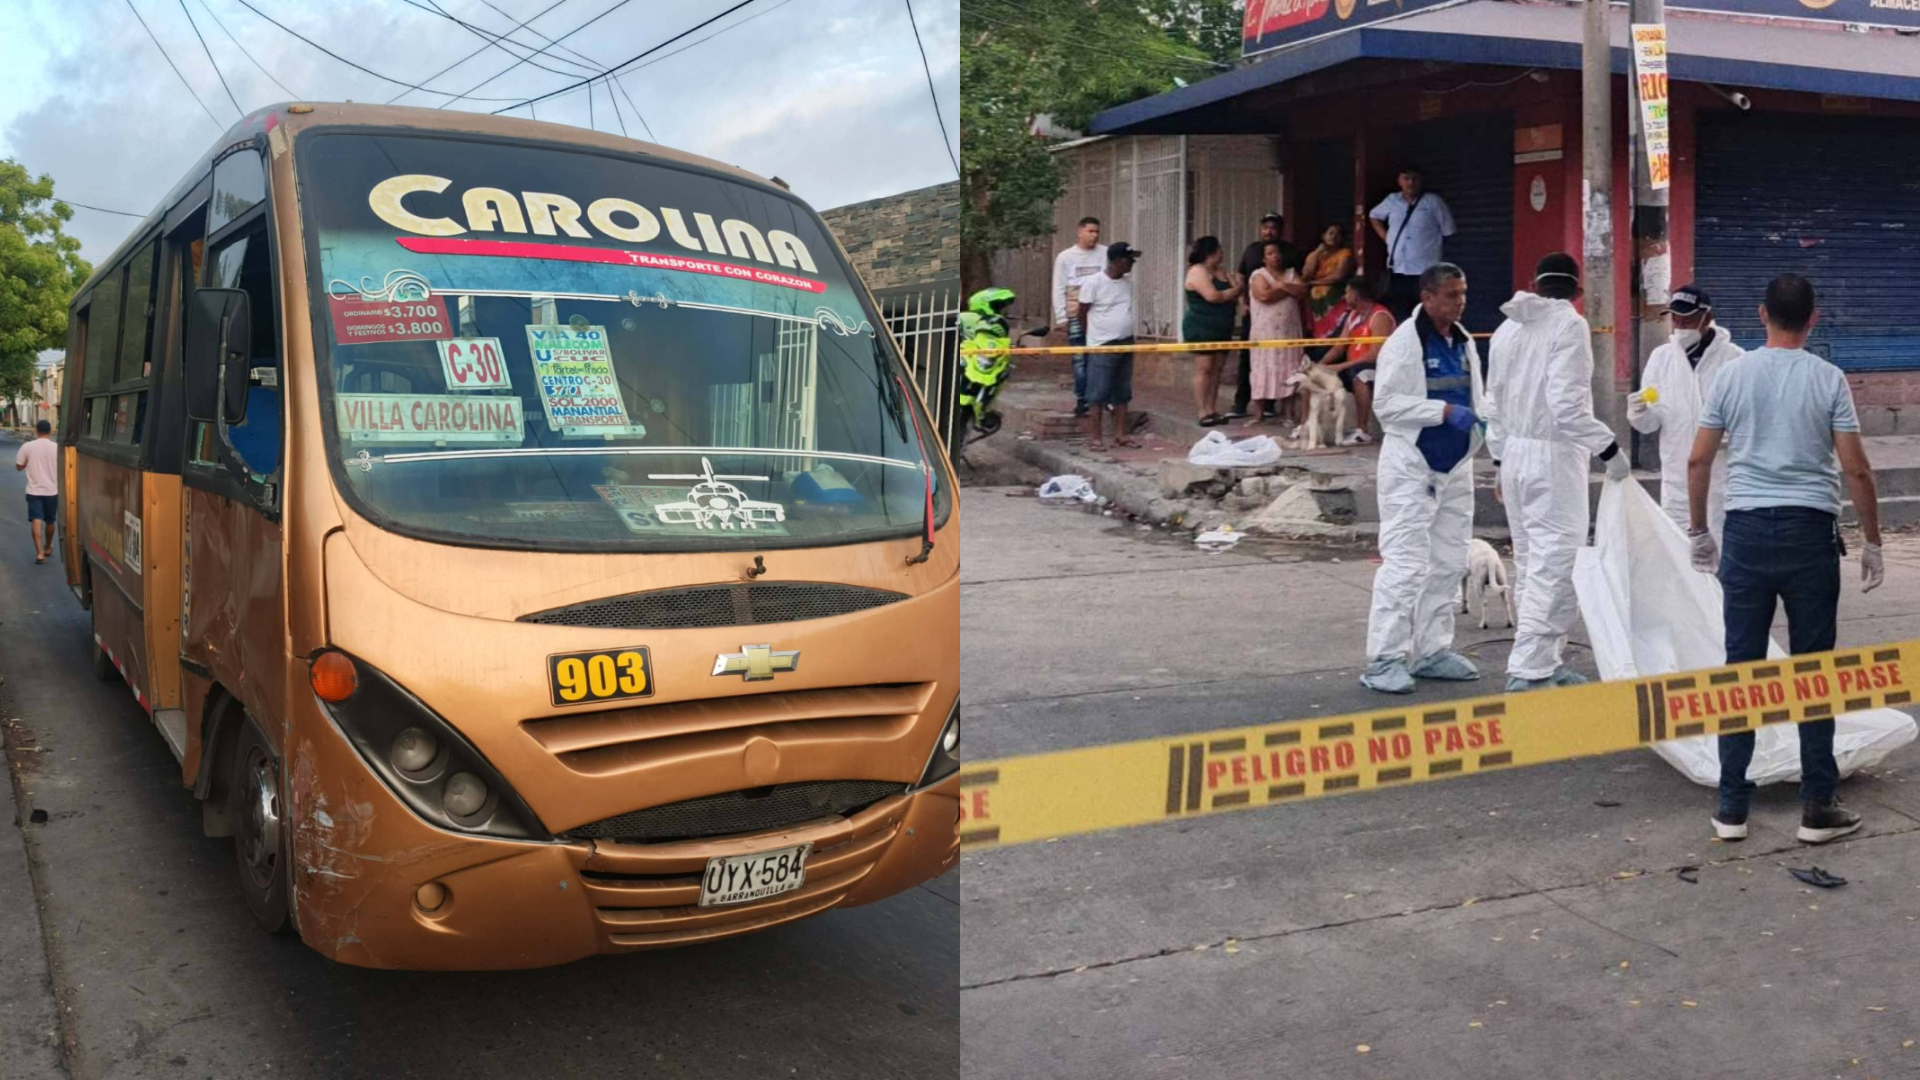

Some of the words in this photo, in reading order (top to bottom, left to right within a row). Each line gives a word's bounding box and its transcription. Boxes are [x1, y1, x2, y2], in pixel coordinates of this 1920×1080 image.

[1871, 0, 1920, 11] ALMACE
[369, 174, 818, 273] CAROLINA
[629, 254, 721, 273] TRANSPORTE
[724, 266, 752, 278] CON
[755, 271, 812, 289] CORAZON
[344, 309, 383, 317] ORDINARIO
[384, 305, 437, 319] $3.700
[388, 321, 443, 335] $3.800
[532, 331, 569, 340] VIA
[576, 330, 601, 340] 40
[534, 340, 604, 349] MALECOM
[535, 349, 552, 362] U
[448, 343, 501, 384] C-30
[552, 363, 577, 375] Portal
[541, 376, 583, 386] CENTRO
[583, 375, 612, 386] C-30
[581, 397, 618, 407] 2000
[344, 400, 405, 431] VILLA
[410, 400, 517, 432] CAROLINA
[551, 406, 623, 416] MANANTIAL
[563, 416, 627, 425] TRANSPORTE
[556, 651, 647, 701] 903
[1668, 680, 1785, 721] PELIGRO
[1793, 673, 1830, 701] NO
[1836, 662, 1903, 694] PASE
[1206, 740, 1354, 790] PELIGRO
[1367, 732, 1412, 764] NO
[1423, 718, 1504, 755] PASE
[720, 883, 786, 902] BARRANQUILLA
